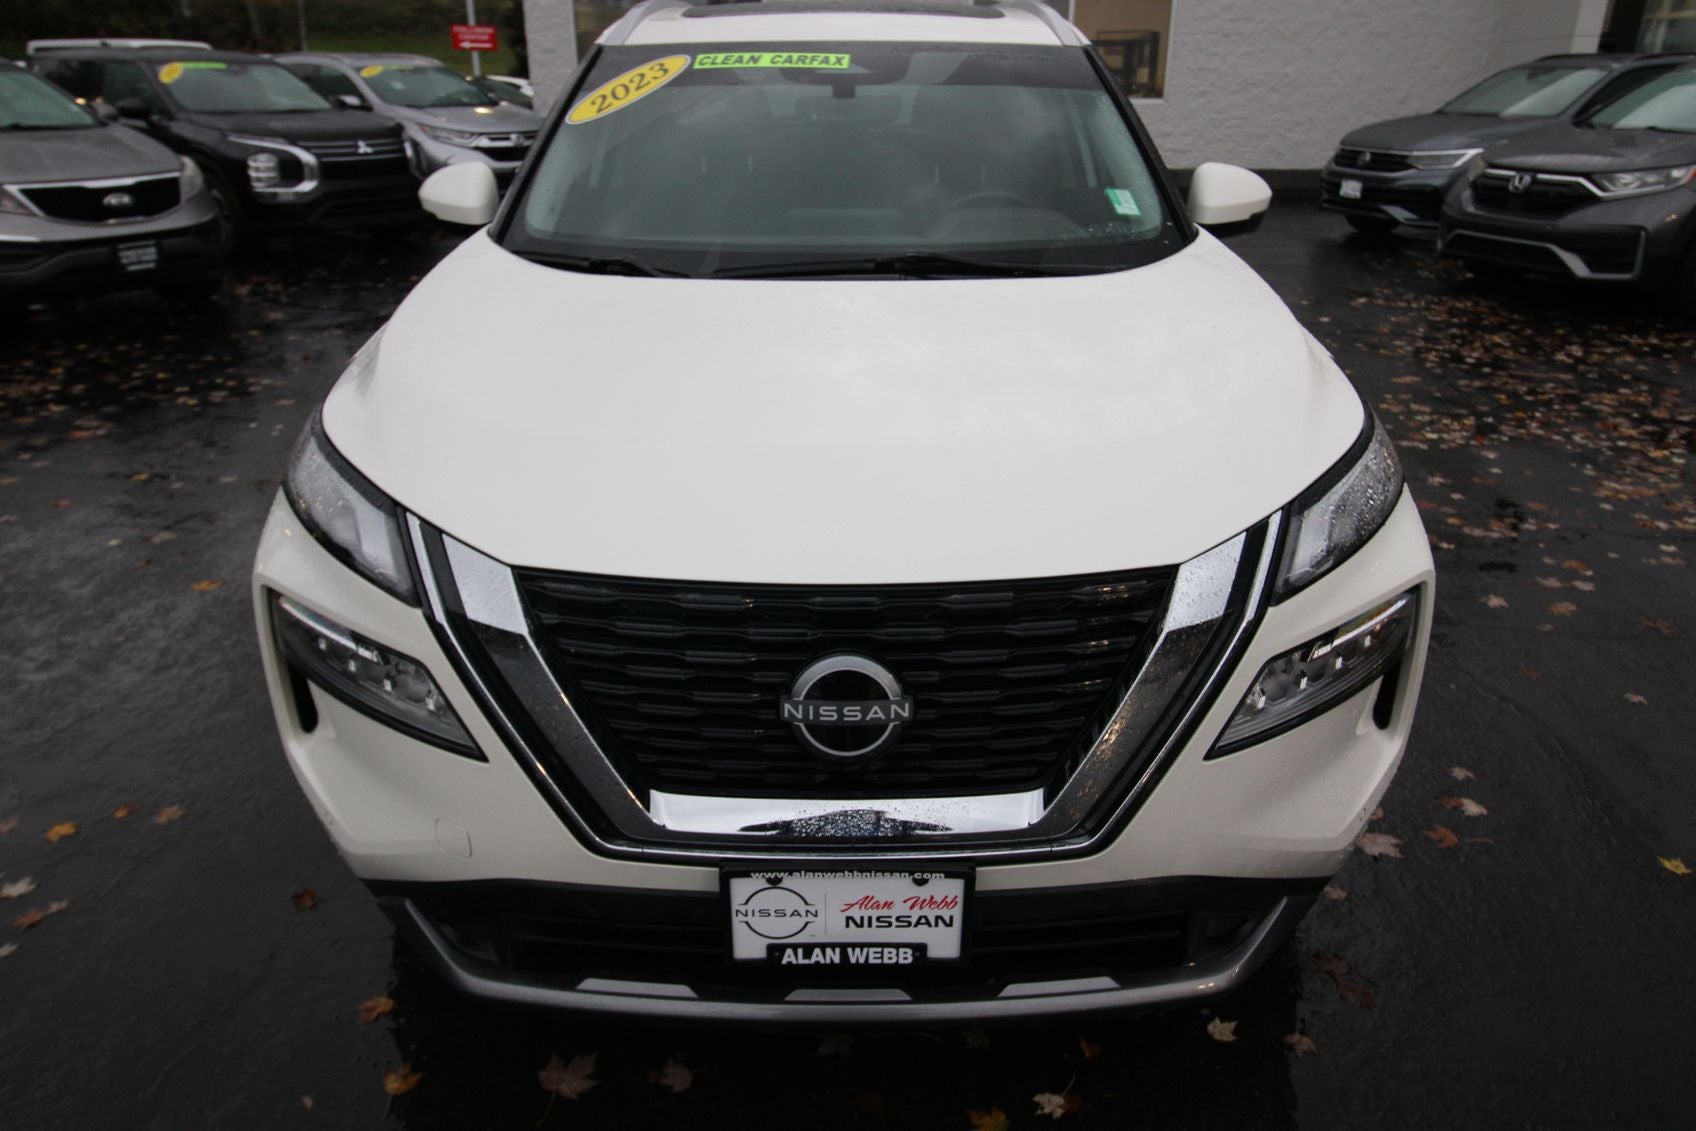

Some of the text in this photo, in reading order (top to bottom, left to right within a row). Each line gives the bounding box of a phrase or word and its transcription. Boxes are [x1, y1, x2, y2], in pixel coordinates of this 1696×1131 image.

[698, 54, 846, 66] CLEAN CARFAX
[589, 62, 670, 114] 2023
[784, 702, 910, 721] NISSAN
[750, 870, 945, 880] www.alanwebbnissan.com
[840, 894, 958, 913] Alan Webb
[735, 908, 818, 918] NISSAN
[845, 915, 954, 929] NISSAN
[781, 947, 913, 964] ALAN WEBB
